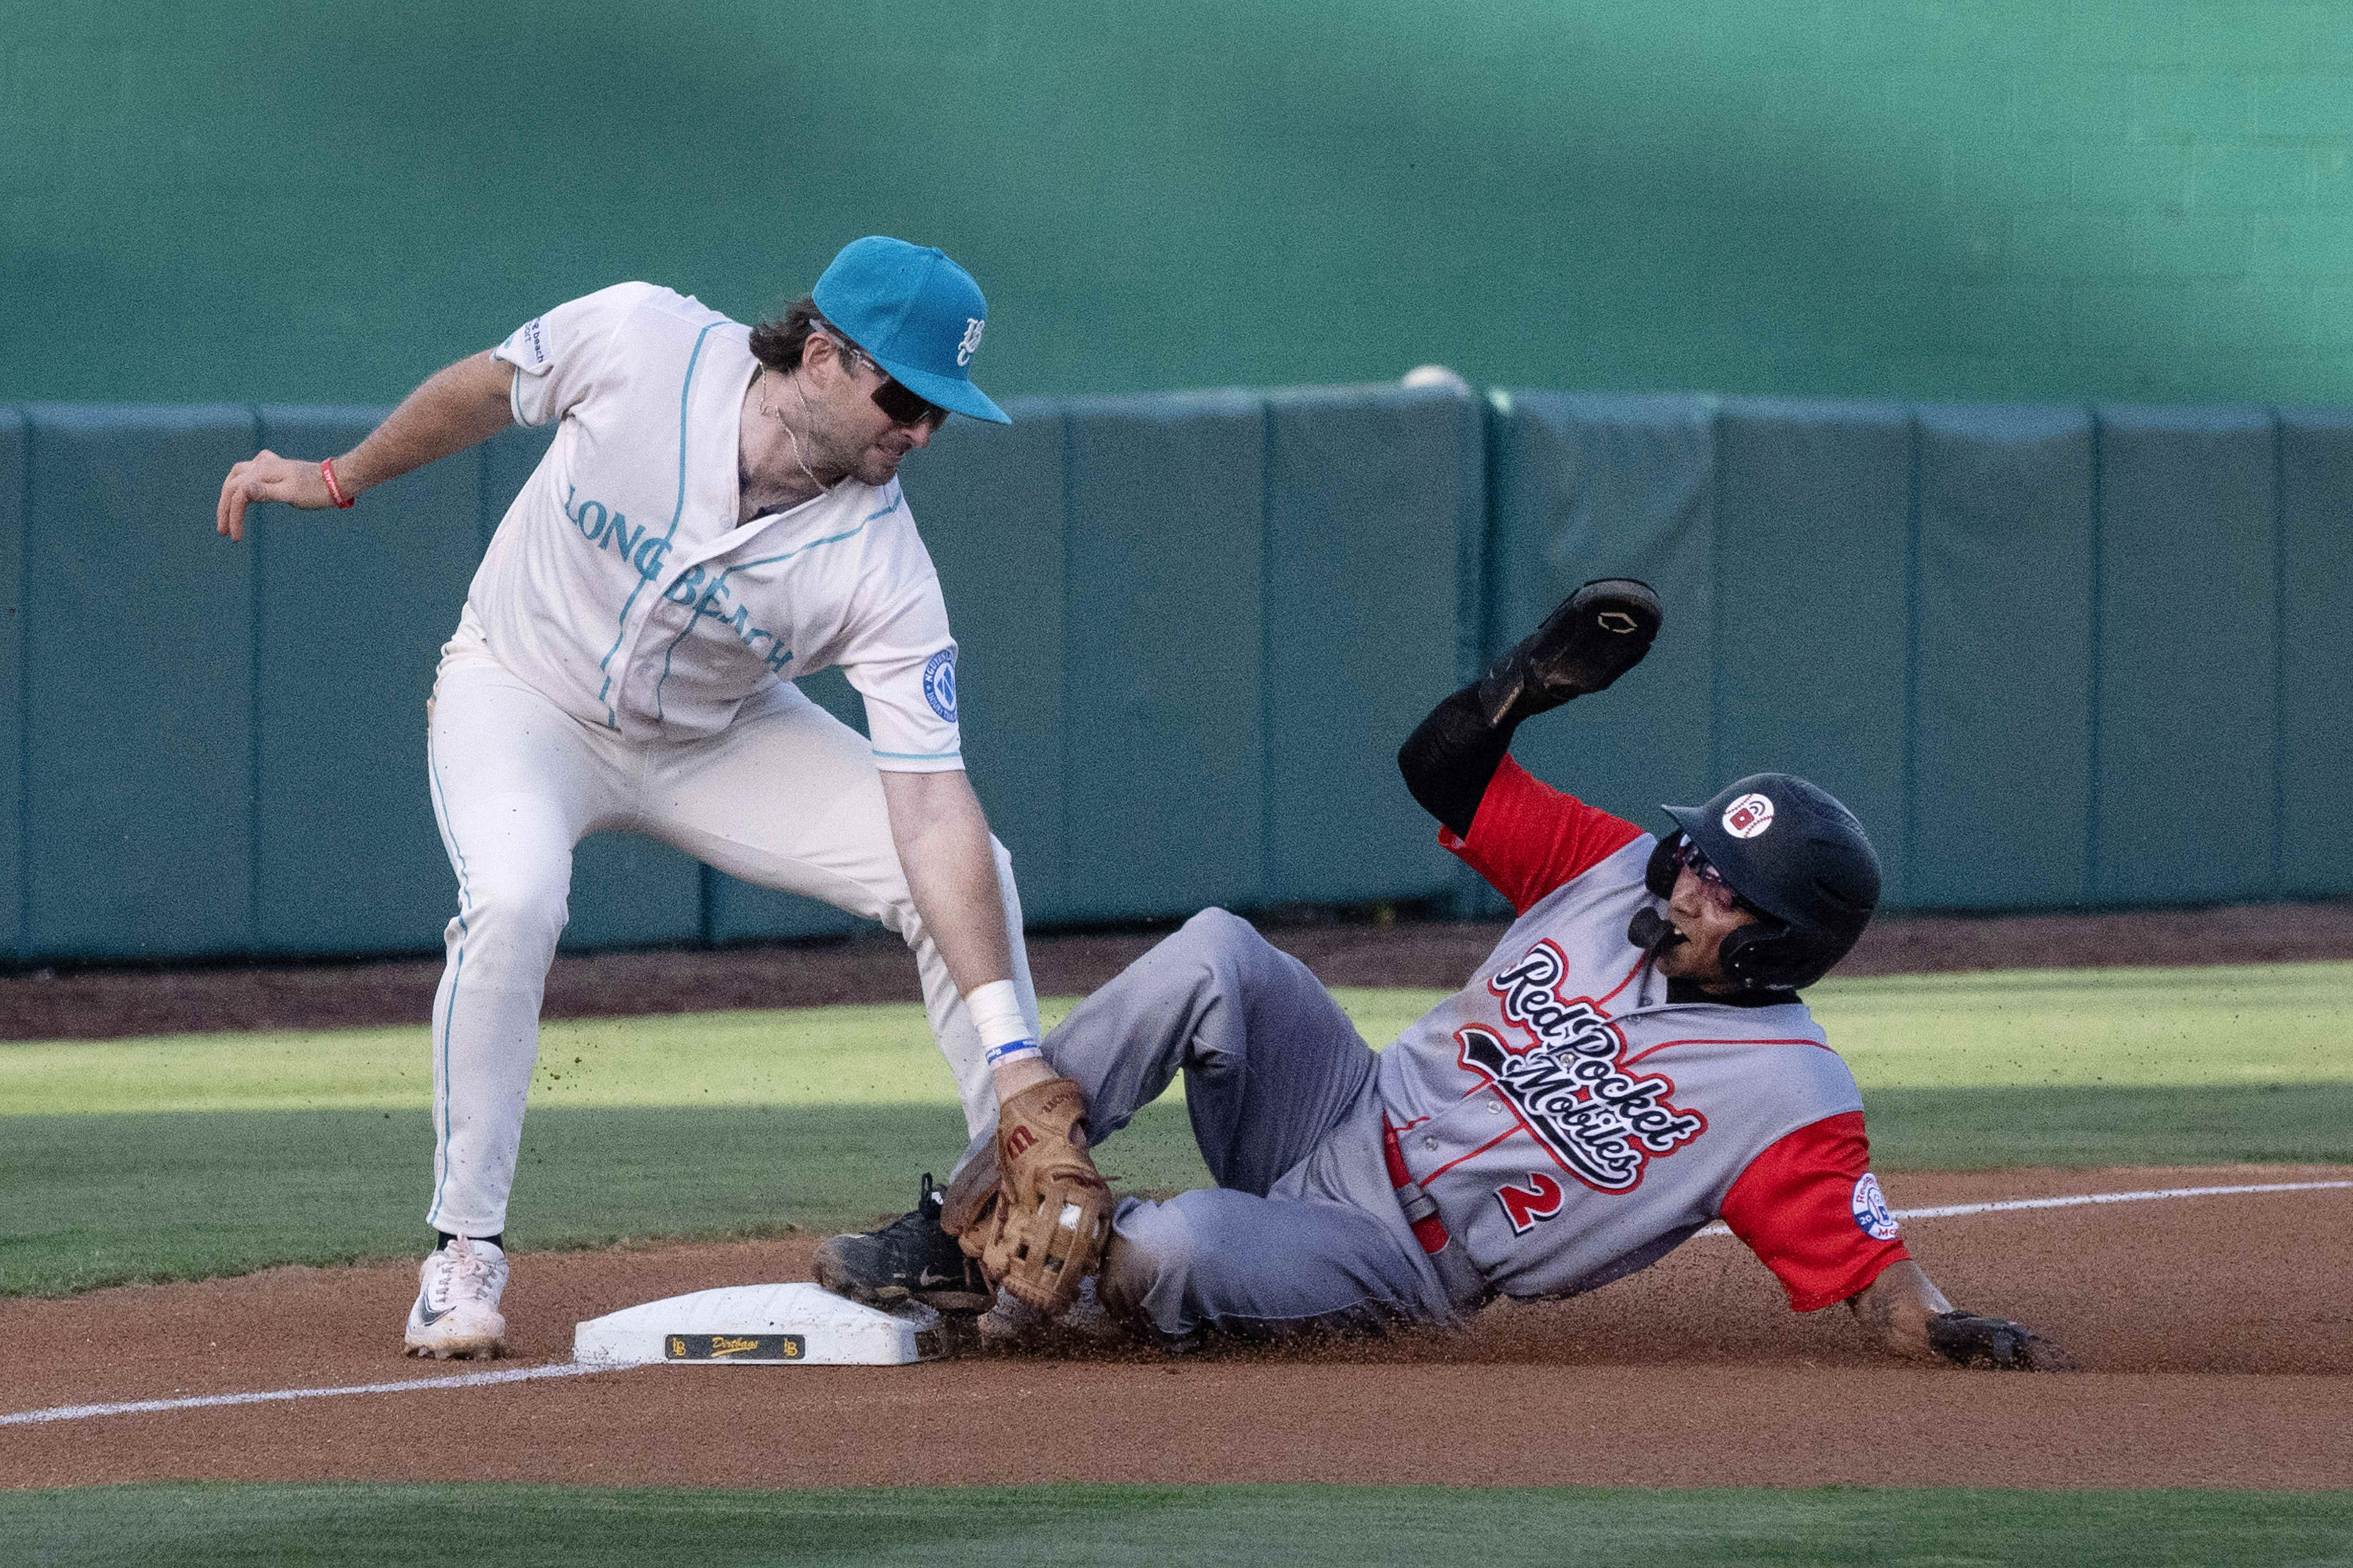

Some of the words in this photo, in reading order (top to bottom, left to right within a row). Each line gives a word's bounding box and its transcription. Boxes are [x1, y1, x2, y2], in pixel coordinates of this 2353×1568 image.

[533, 331, 544, 363] beach
[564, 484, 673, 581] LONG
[664, 563, 794, 673] BEACH
[1493, 946, 1590, 1039] Red
[1546, 1017, 1698, 1148] Pocket
[1503, 1052, 1638, 1172] Mobiles
[1493, 1172, 1565, 1237] 2
[672, 1337, 686, 1357] LB
[784, 1337, 798, 1357] LB
